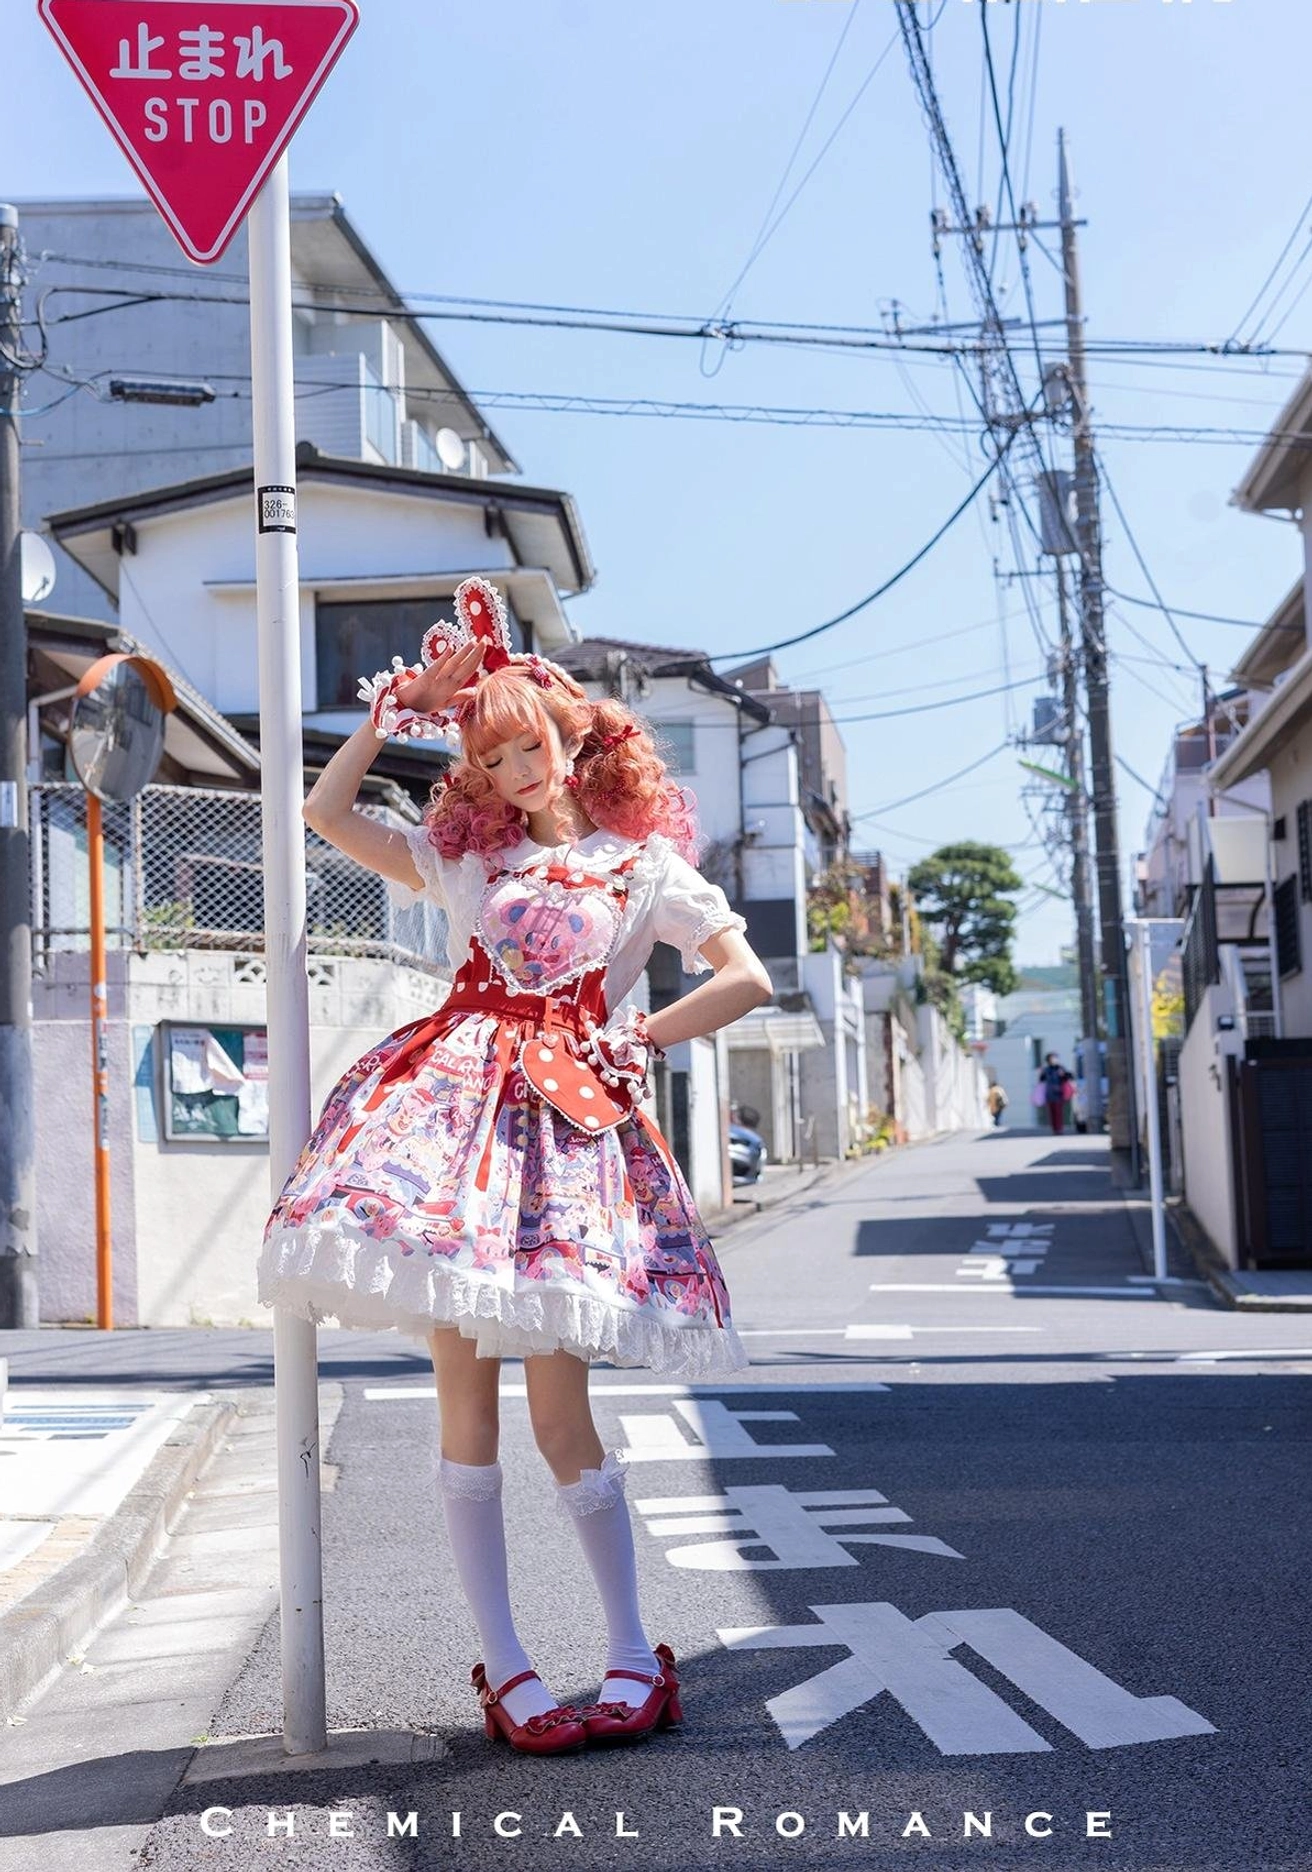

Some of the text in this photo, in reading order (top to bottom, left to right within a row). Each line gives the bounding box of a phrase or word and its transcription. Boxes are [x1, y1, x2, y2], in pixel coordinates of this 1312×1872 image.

[109, 22, 293, 81] 止まれ
[144, 97, 267, 144] STOP
[619, 1400, 1220, 1756] 止まれ
